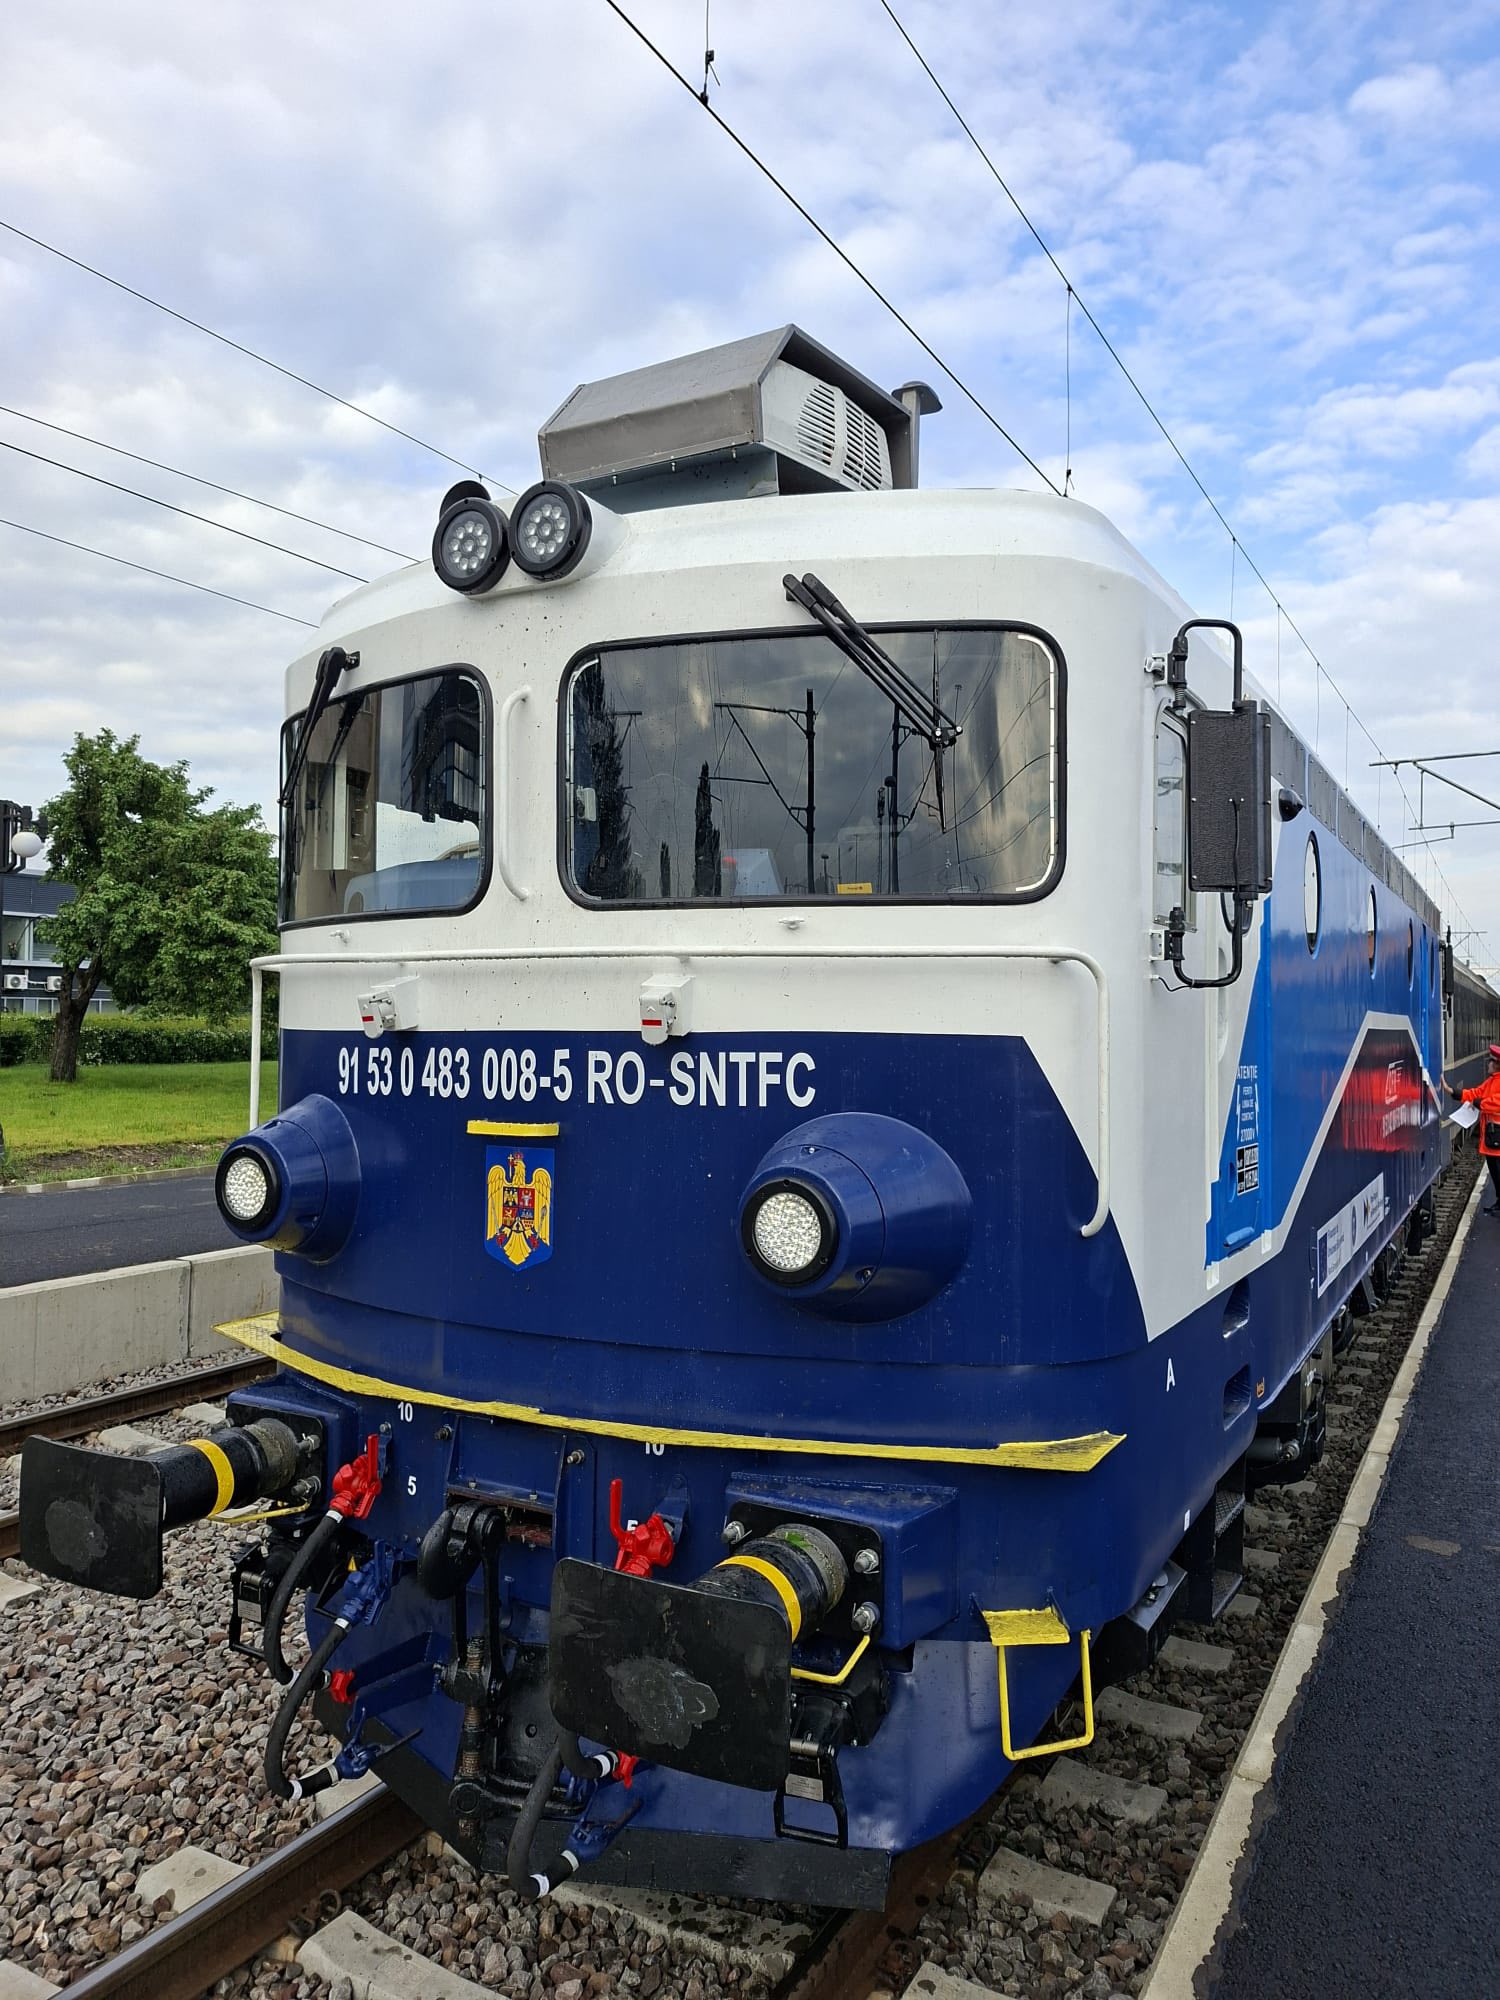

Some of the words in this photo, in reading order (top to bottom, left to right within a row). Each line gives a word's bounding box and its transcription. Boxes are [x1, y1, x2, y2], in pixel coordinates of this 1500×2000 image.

[339, 1047, 359, 1095] 91
[367, 1047, 393, 1096] 53
[400, 1047, 414, 1097] 0
[421, 1047, 471, 1099] 483
[482, 1048, 573, 1102] 008-5
[587, 1050, 816, 1108] RO-SNTFC
[1166, 1358, 1176, 1392] A
[397, 1401, 413, 1422] 10
[407, 1475, 417, 1496] 5
